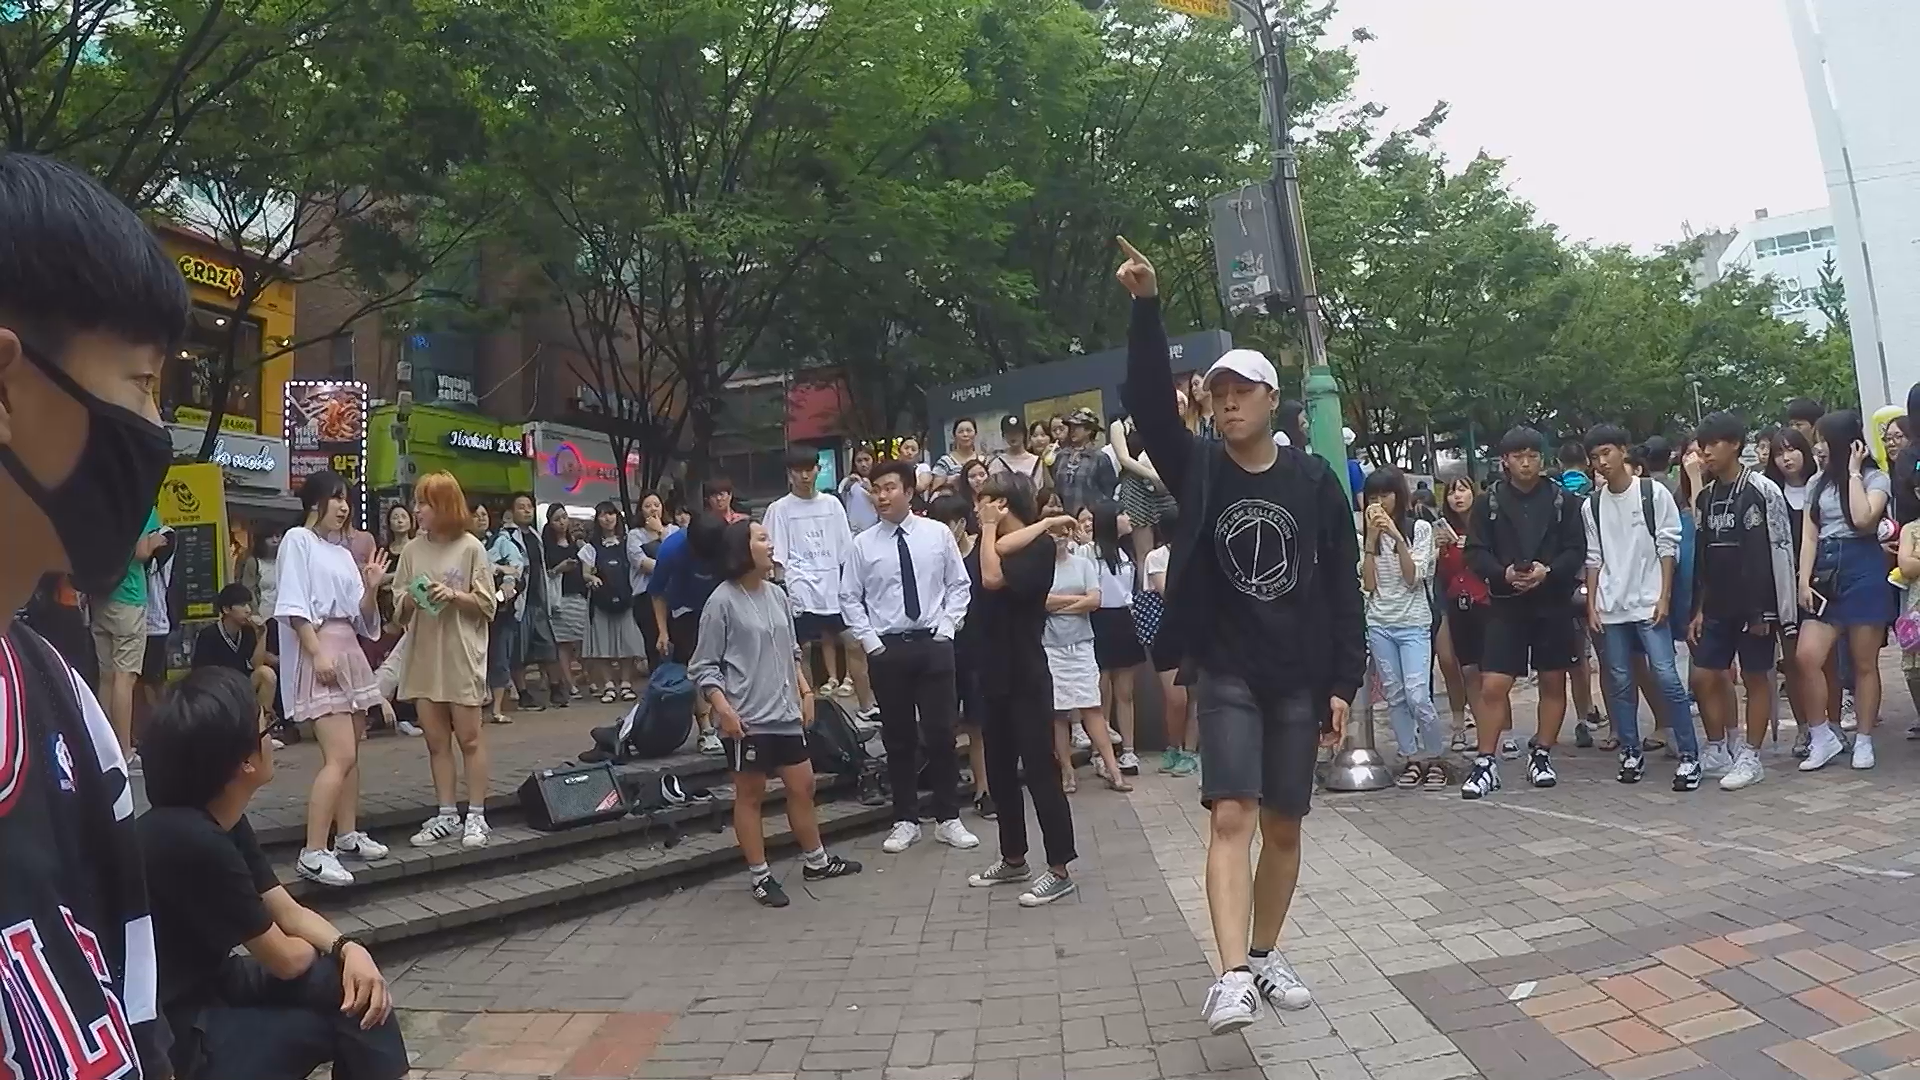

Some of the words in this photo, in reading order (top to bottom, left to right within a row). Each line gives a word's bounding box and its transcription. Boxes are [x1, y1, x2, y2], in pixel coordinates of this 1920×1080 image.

[951, 383, 992, 402] 시민게시판
[449, 429, 493, 451] Hookah
[497, 437, 523, 455] BAR
[333, 454, 360, 471] 입구
